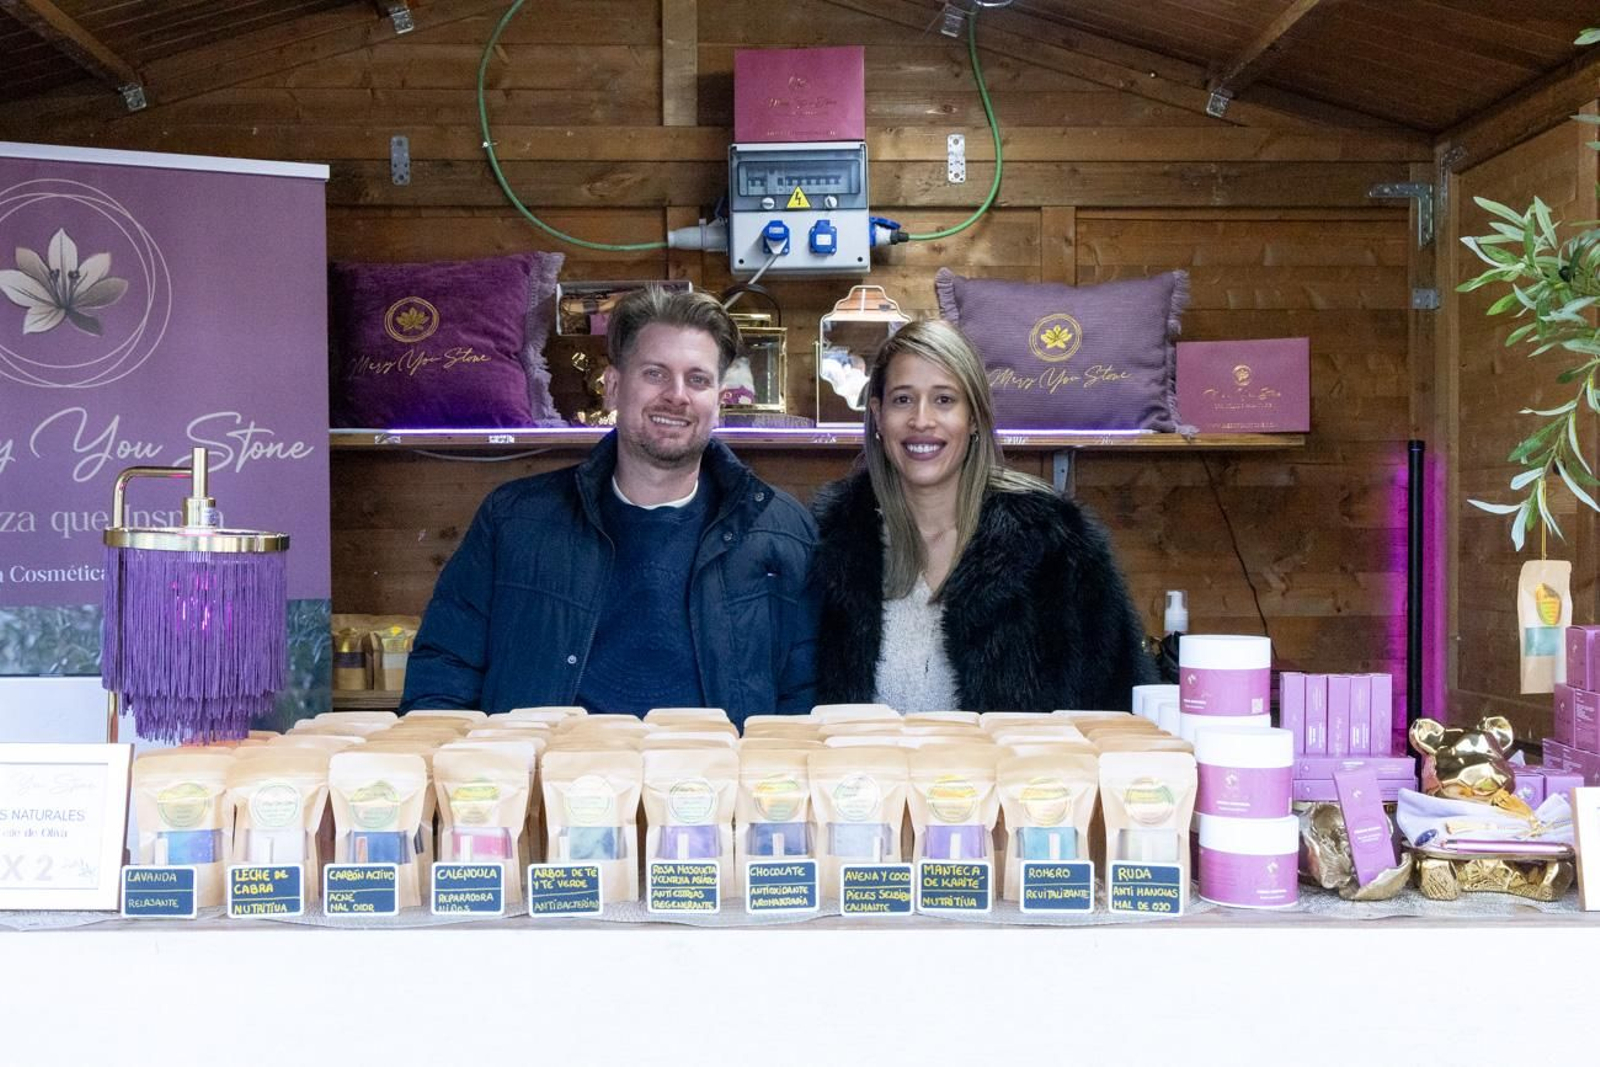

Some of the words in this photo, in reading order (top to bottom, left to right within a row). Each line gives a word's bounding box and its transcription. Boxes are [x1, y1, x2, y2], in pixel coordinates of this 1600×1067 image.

[398, 349, 441, 375] You
[443, 347, 492, 369] Stone
[1083, 364, 1133, 388] Stone
[30, 407, 163, 482] You
[172, 411, 314, 473] Stone
[51, 508, 109, 540] que
[11, 809, 86, 822] NATURALES
[35, 853, 54, 881] 2
[653, 865, 675, 874] ROSA
[750, 866, 806, 876] CHOCOLATE
[923, 864, 980, 876] MANTECA
[1028, 867, 1071, 878] ROMERO
[127, 871, 177, 882] LAVANDA
[234, 868, 270, 881] LECHE
[274, 870, 289, 880] DE
[571, 869, 583, 877] DE
[845, 871, 879, 881] AVENA
[880, 870, 887, 882] Y
[889, 872, 910, 881] COCO
[1118, 867, 1152, 881] RUDA
[533, 881, 539, 890] Y
[556, 879, 588, 888] VERDE
[923, 877, 938, 887] DE
[234, 883, 273, 894] CABRA
[128, 898, 179, 908] RELAJANTE
[438, 892, 494, 903] REPARADORA
[1137, 901, 1149, 910] DE
[1152, 902, 1171, 912] OJO
